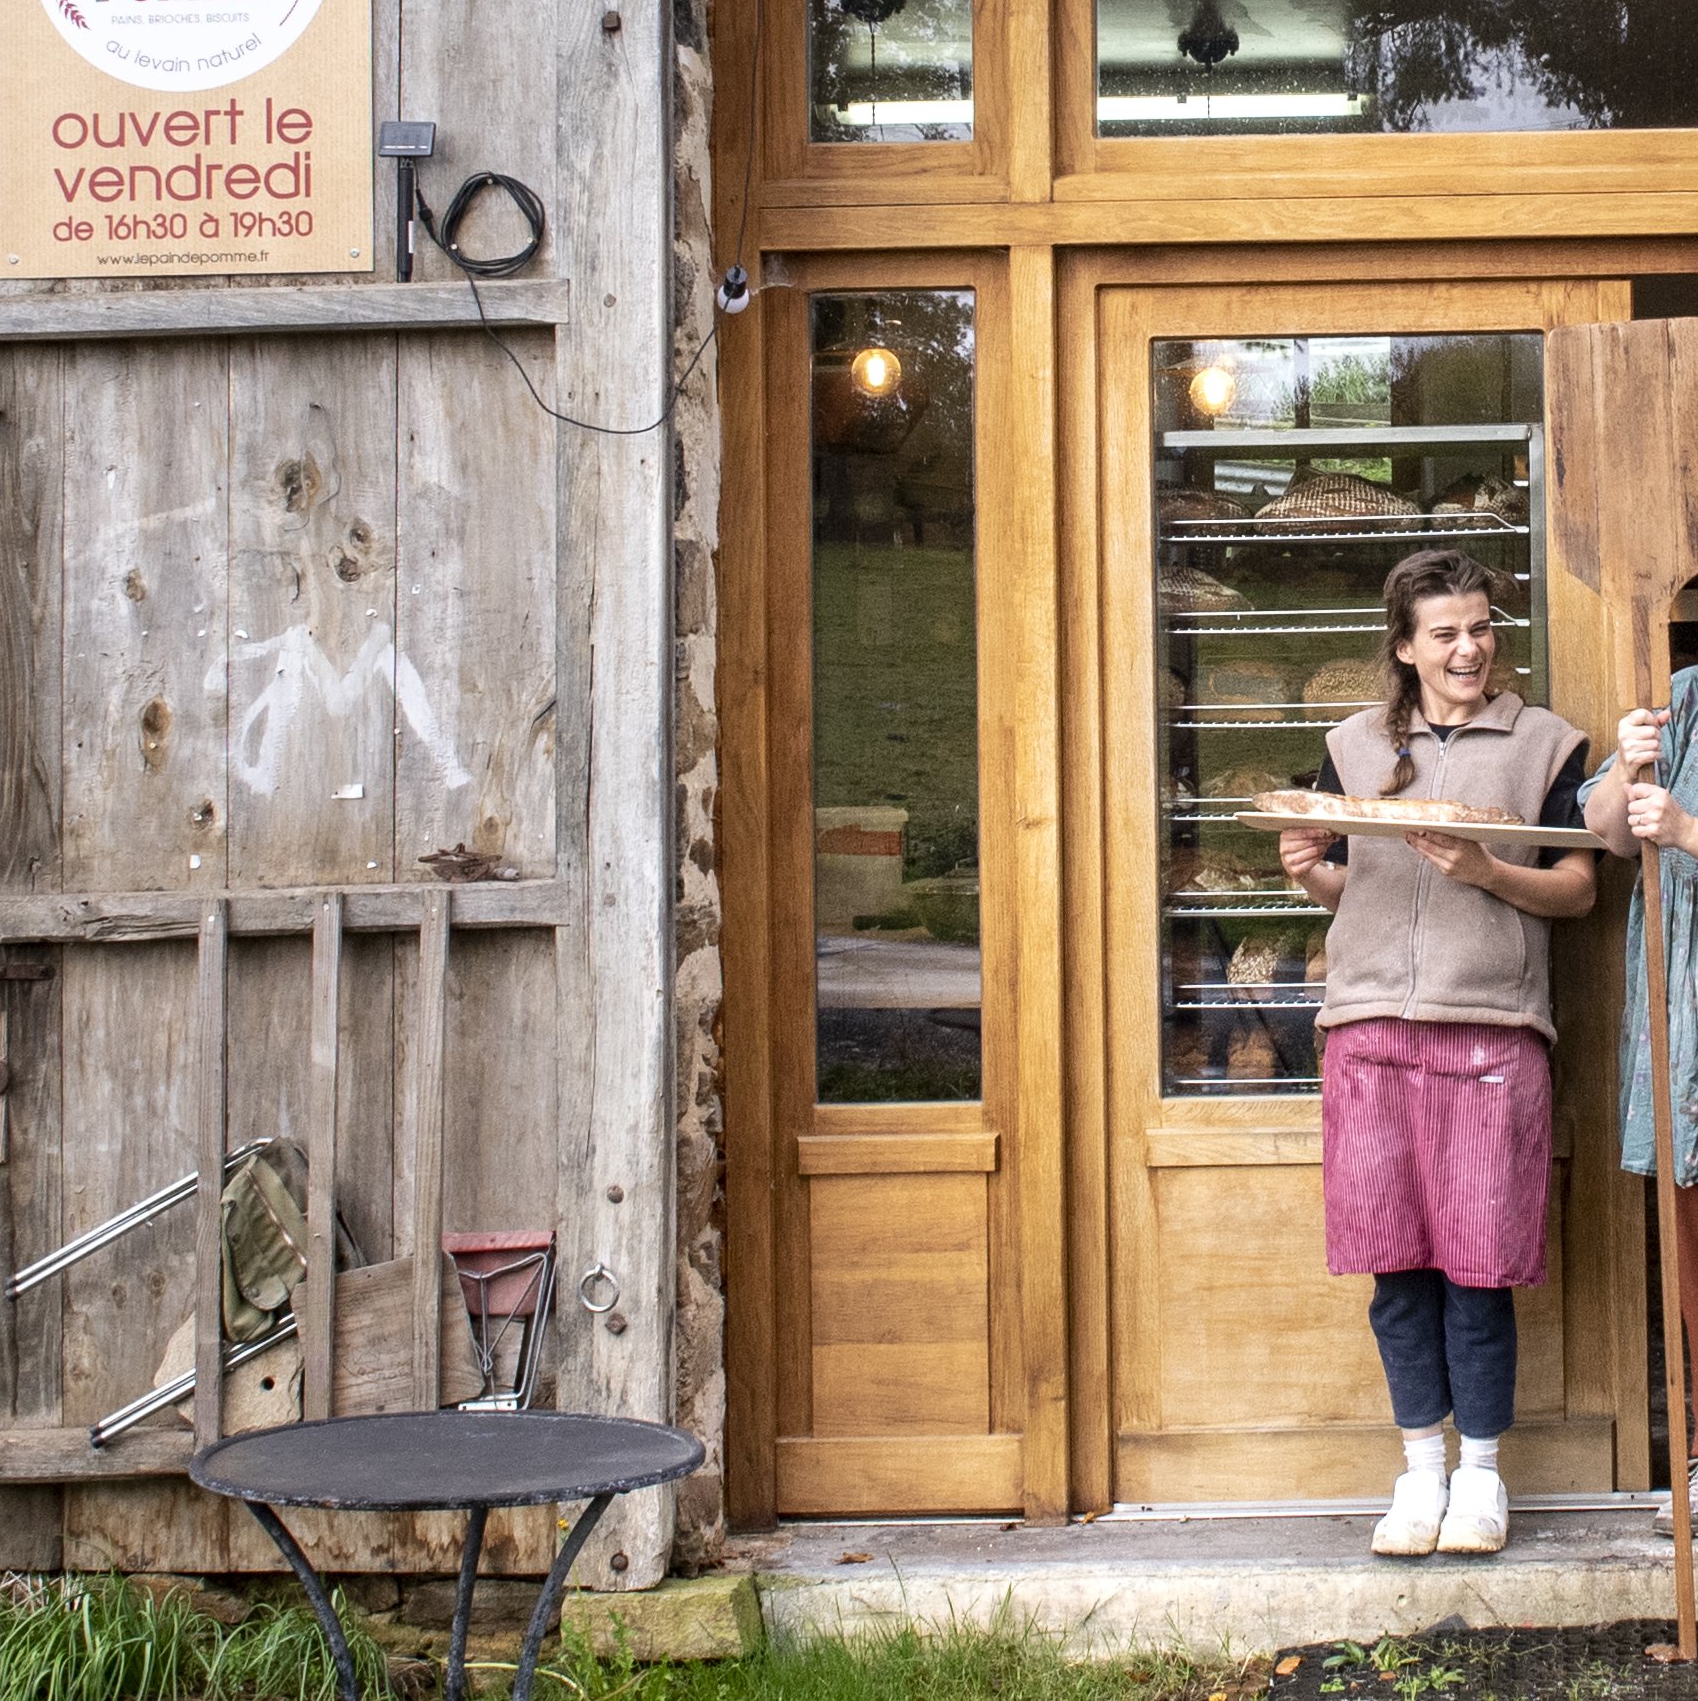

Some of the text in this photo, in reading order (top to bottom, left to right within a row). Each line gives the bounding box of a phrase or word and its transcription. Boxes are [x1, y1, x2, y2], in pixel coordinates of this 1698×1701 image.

[206, 12, 251, 23] BISCUITS
[106, 32, 262, 73] au levain naturel
[51, 97, 314, 149] ouvert le
[52, 151, 313, 203] vendredi
[52, 209, 315, 242] de 16h30 à 19h30
[96, 250, 270, 266] www.lepaindepomme.fr
